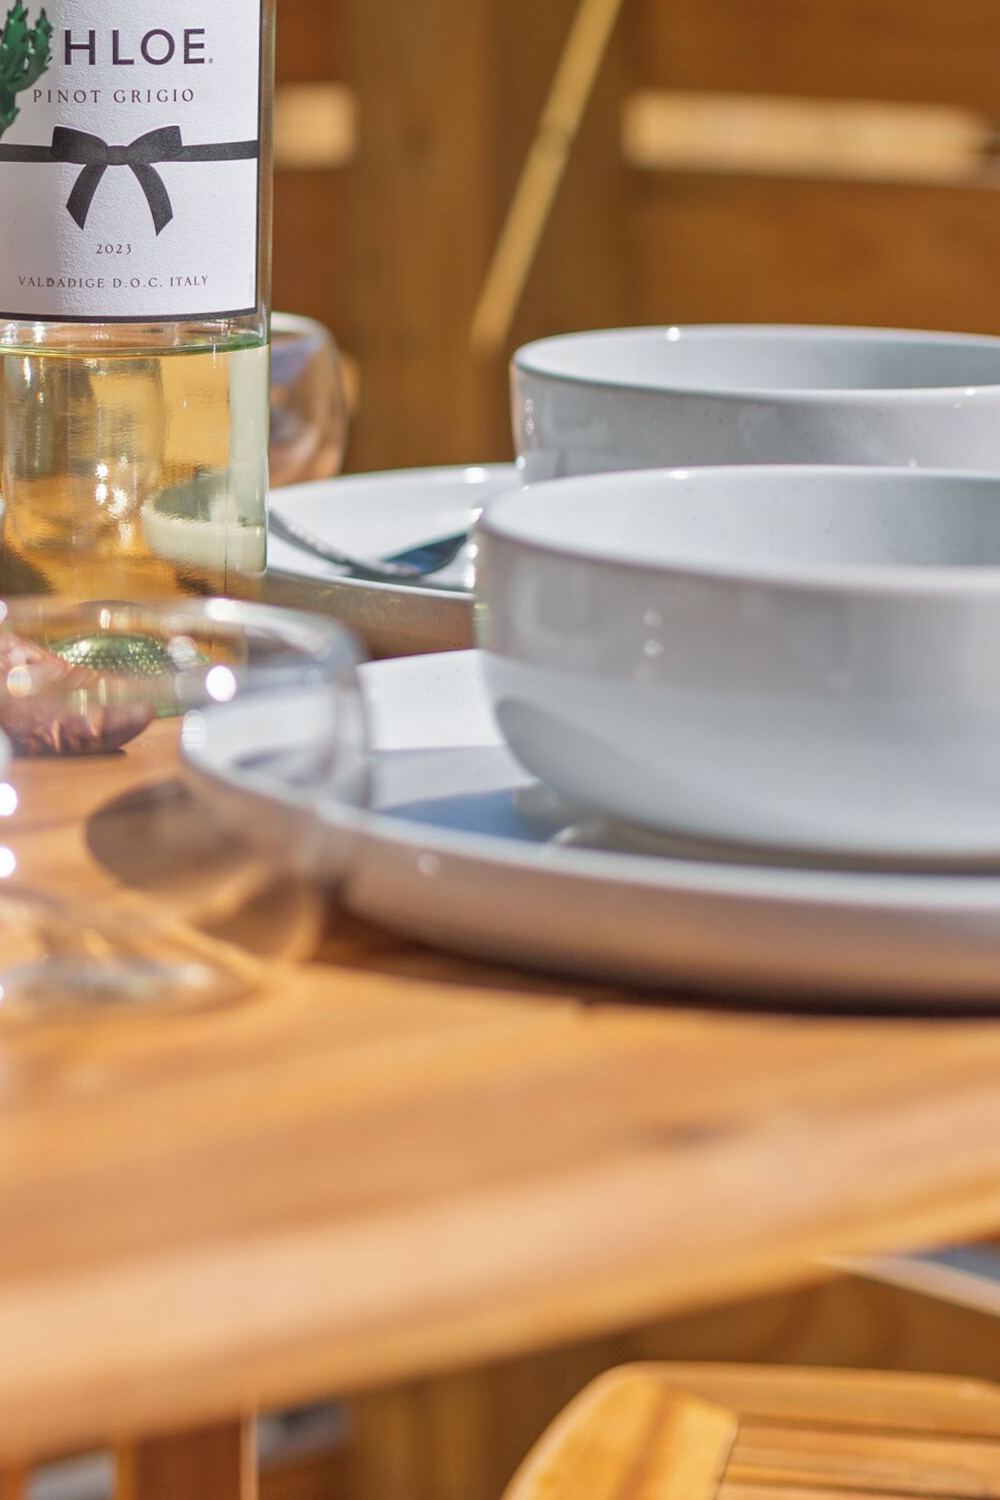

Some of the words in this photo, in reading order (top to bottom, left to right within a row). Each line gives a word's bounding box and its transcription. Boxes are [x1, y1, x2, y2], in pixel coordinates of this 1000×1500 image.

[64, 28, 205, 65] HLOE
[33, 89, 101, 103] PINOT
[113, 88, 194, 103] GRIGIO
[96, 243, 132, 254] 2023
[18, 276, 105, 288] VALDADIGE
[112, 277, 163, 288] D.O.C.
[170, 275, 209, 287] ITALY
